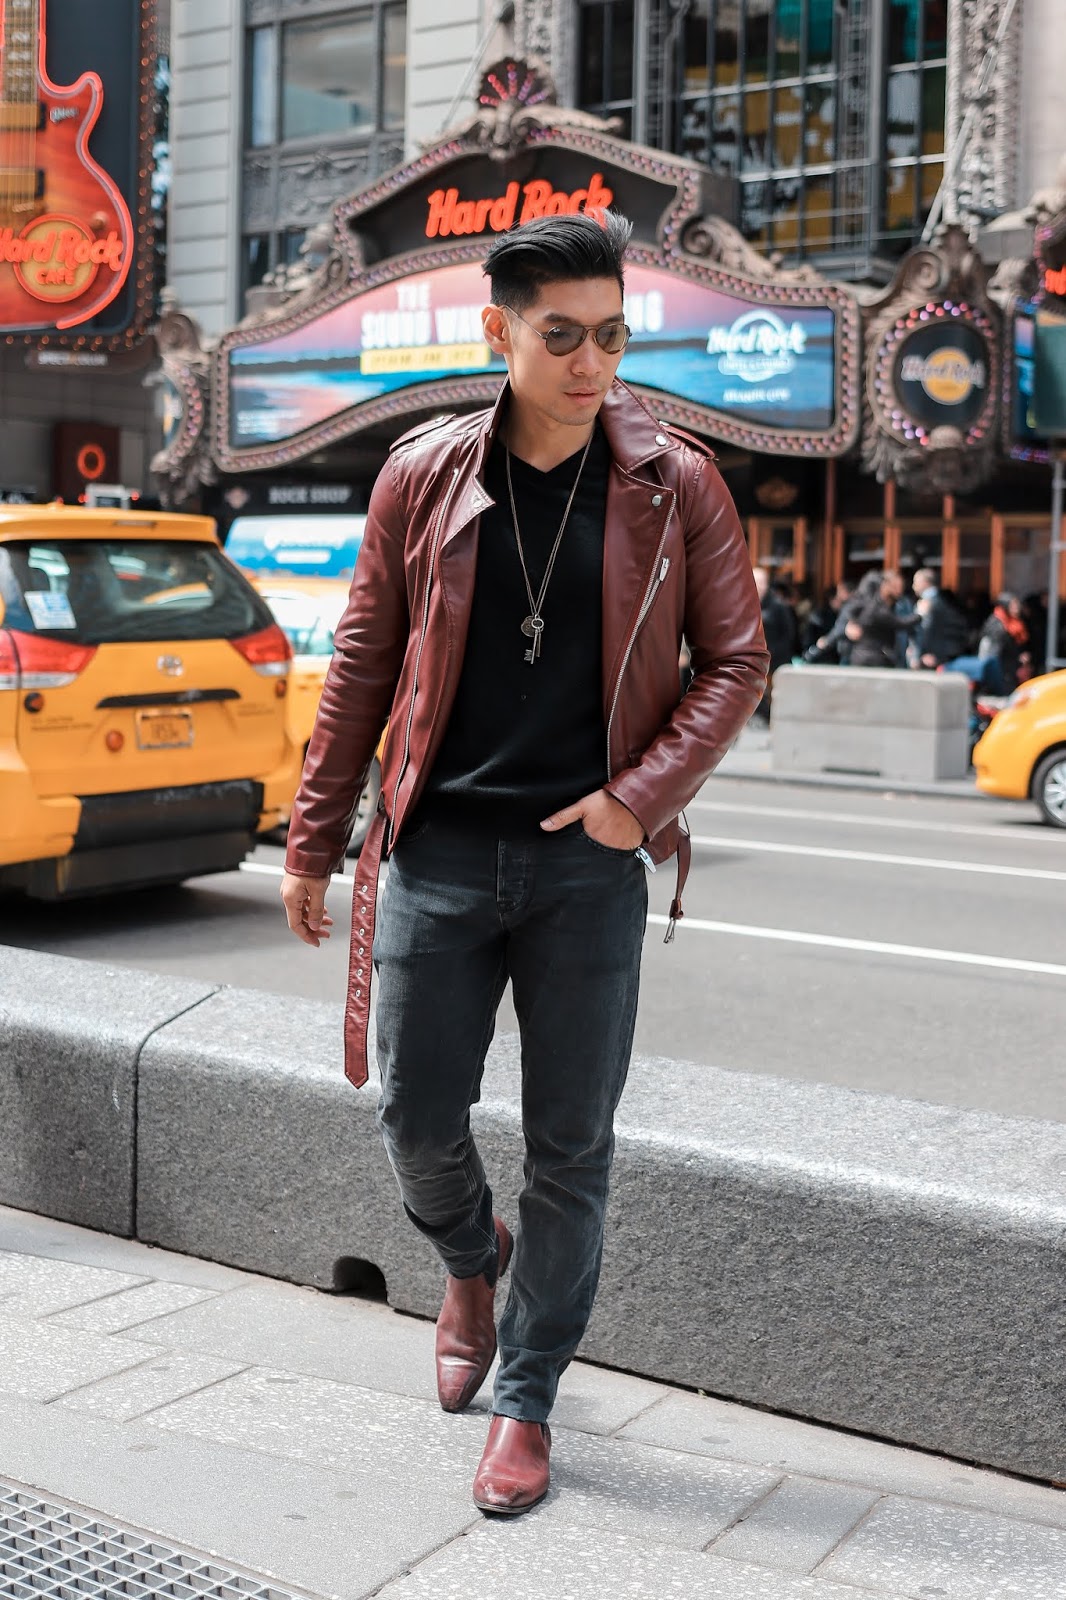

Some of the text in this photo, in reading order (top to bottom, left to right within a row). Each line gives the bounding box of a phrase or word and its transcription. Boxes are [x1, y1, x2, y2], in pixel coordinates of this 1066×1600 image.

[426, 172, 614, 238] Hard Rock
[0, 227, 124, 272] Hard Rock
[36, 267, 77, 285] CAFE
[706, 321, 807, 356] Hard Rock
